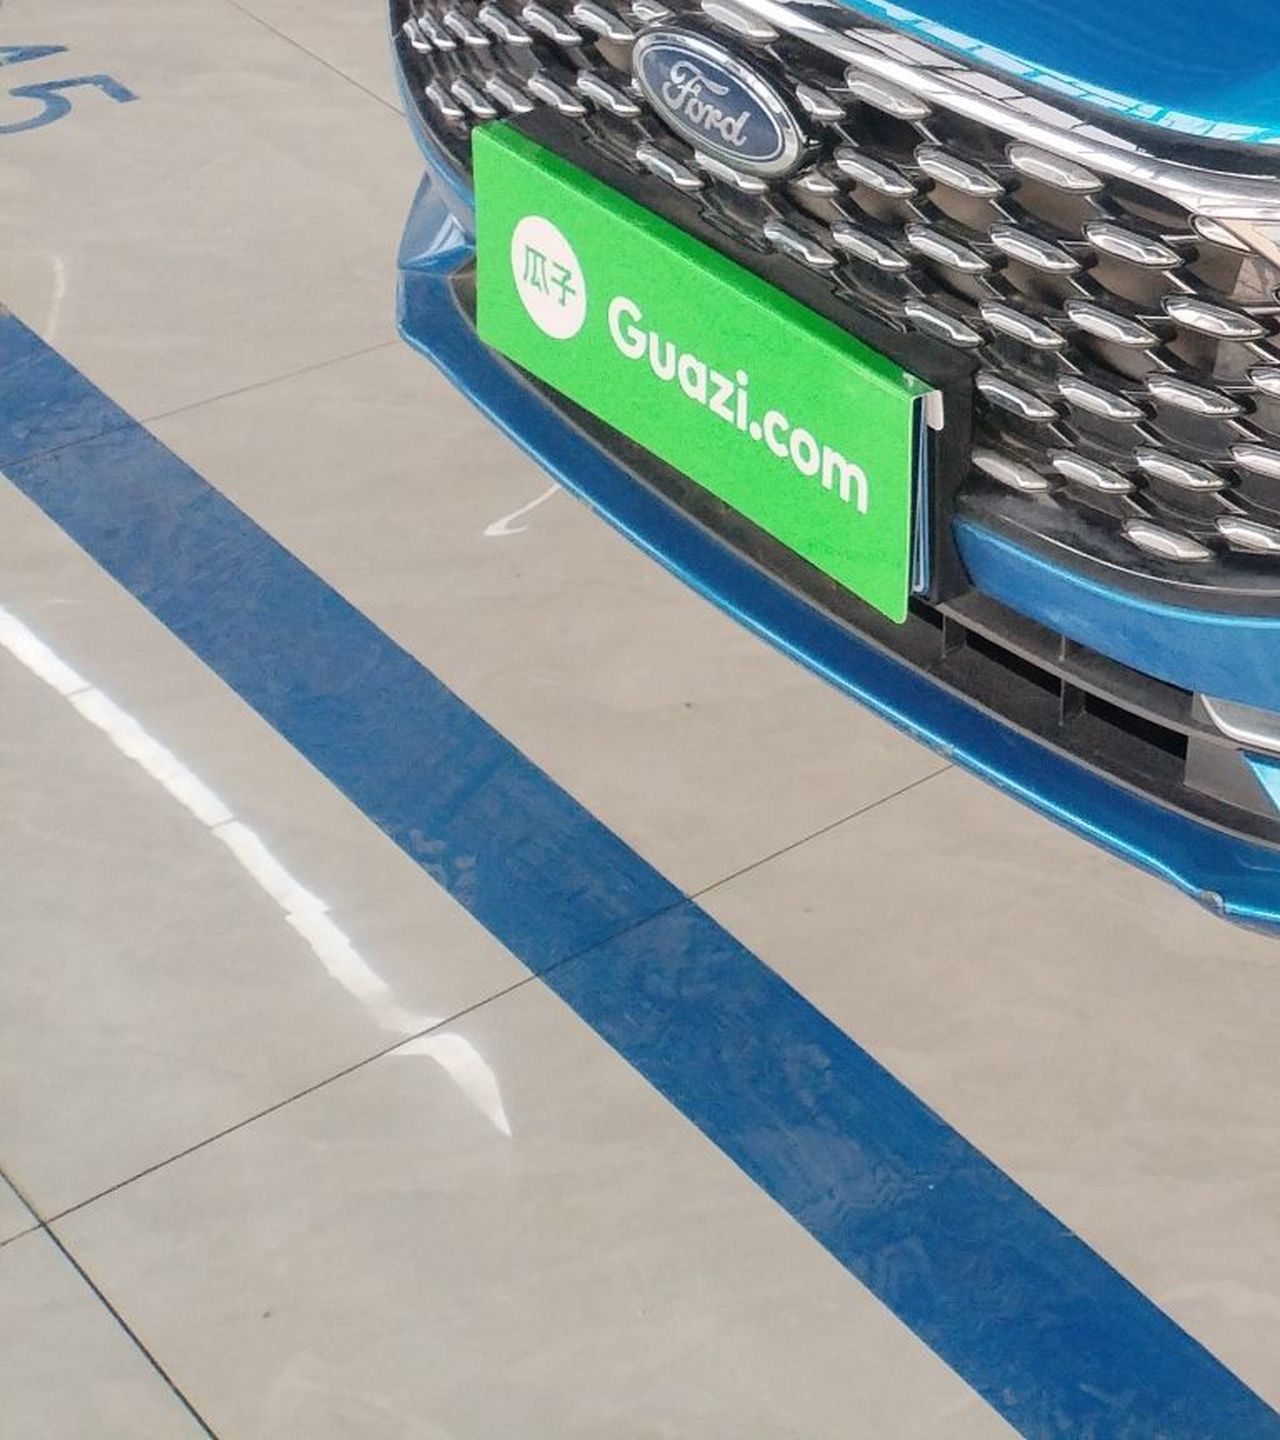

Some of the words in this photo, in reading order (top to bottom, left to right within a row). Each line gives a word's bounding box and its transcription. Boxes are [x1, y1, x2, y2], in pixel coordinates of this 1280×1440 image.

[662, 60, 750, 147] Ford
[523, 244, 576, 307] 瓜子
[607, 295, 868, 514] Guazi.com
